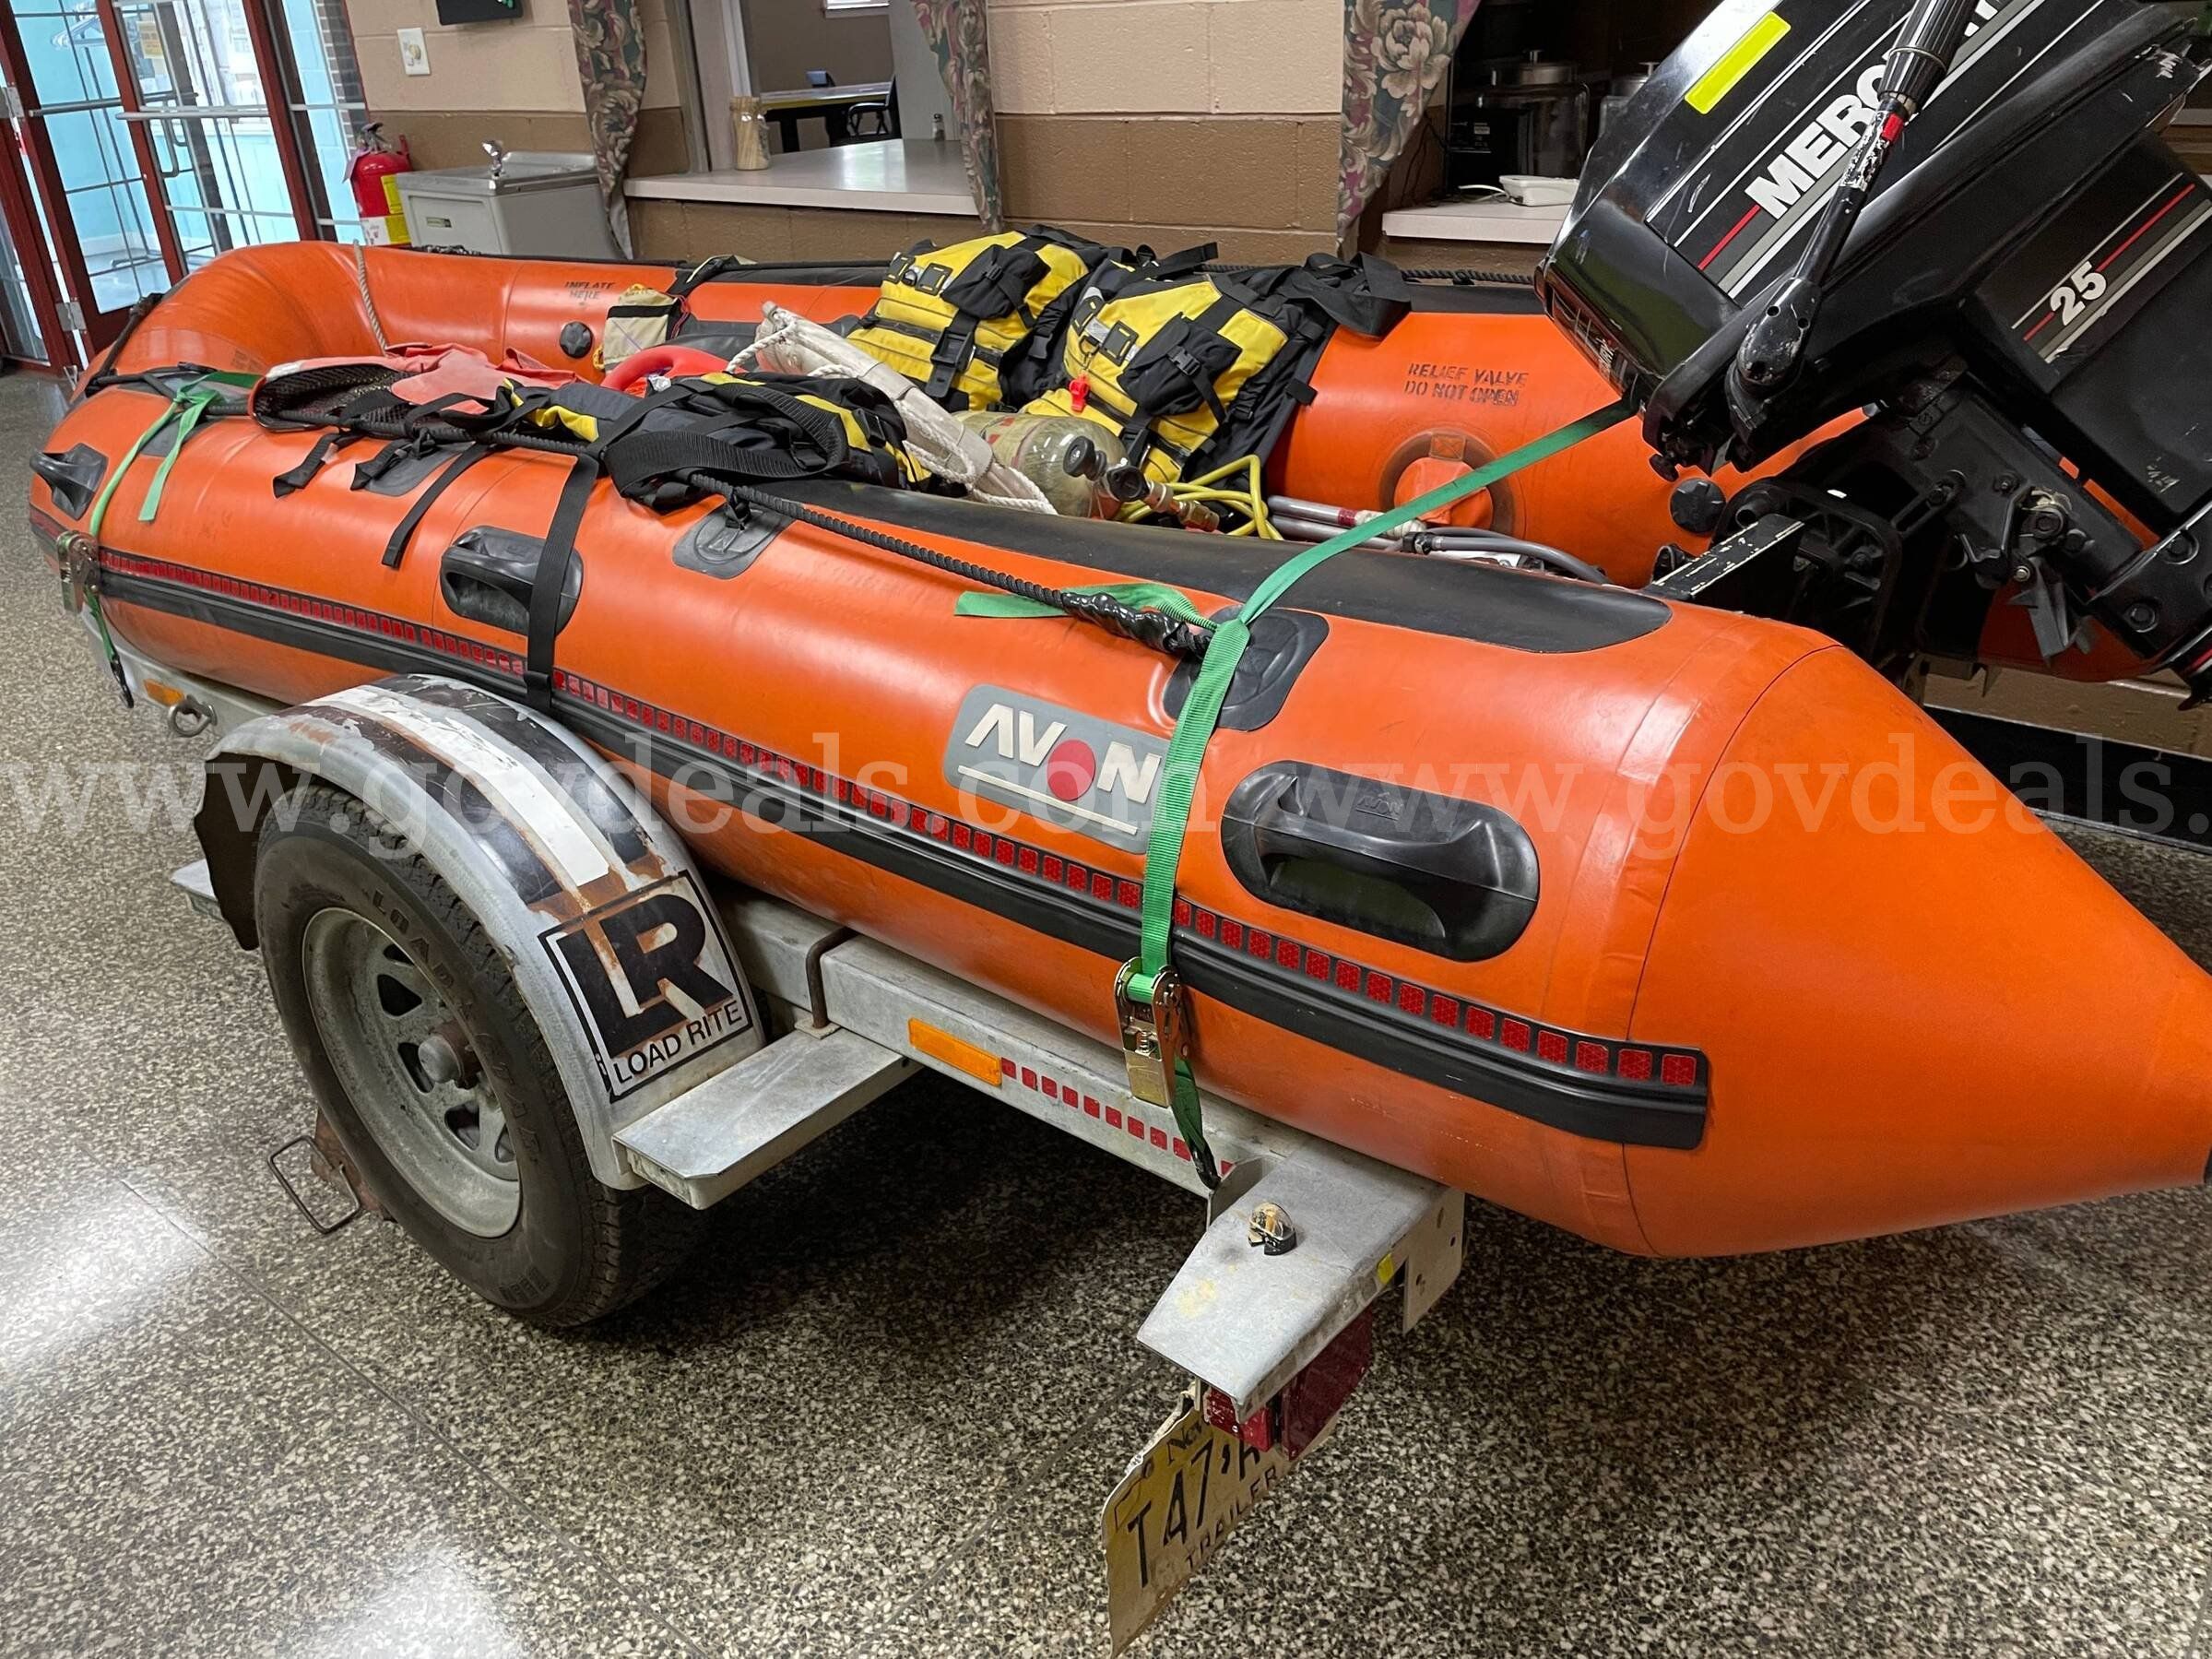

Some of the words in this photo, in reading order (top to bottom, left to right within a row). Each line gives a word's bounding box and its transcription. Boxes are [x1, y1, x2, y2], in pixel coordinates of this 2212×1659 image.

[563, 280, 616, 290] INFLATE
[2050, 260, 2107, 326] 25
[1404, 380, 1428, 396] DO
[1432, 383, 1468, 400] NOT
[1408, 362, 1469, 380] RELIEF
[1474, 368, 1529, 388] VALVE
[964, 703, 1162, 805] AVON
[372, 886, 455, 989] LOAD
[555, 894, 734, 1059] LR
[612, 1033, 681, 1084] LOAD
[686, 999, 743, 1046] RITE
